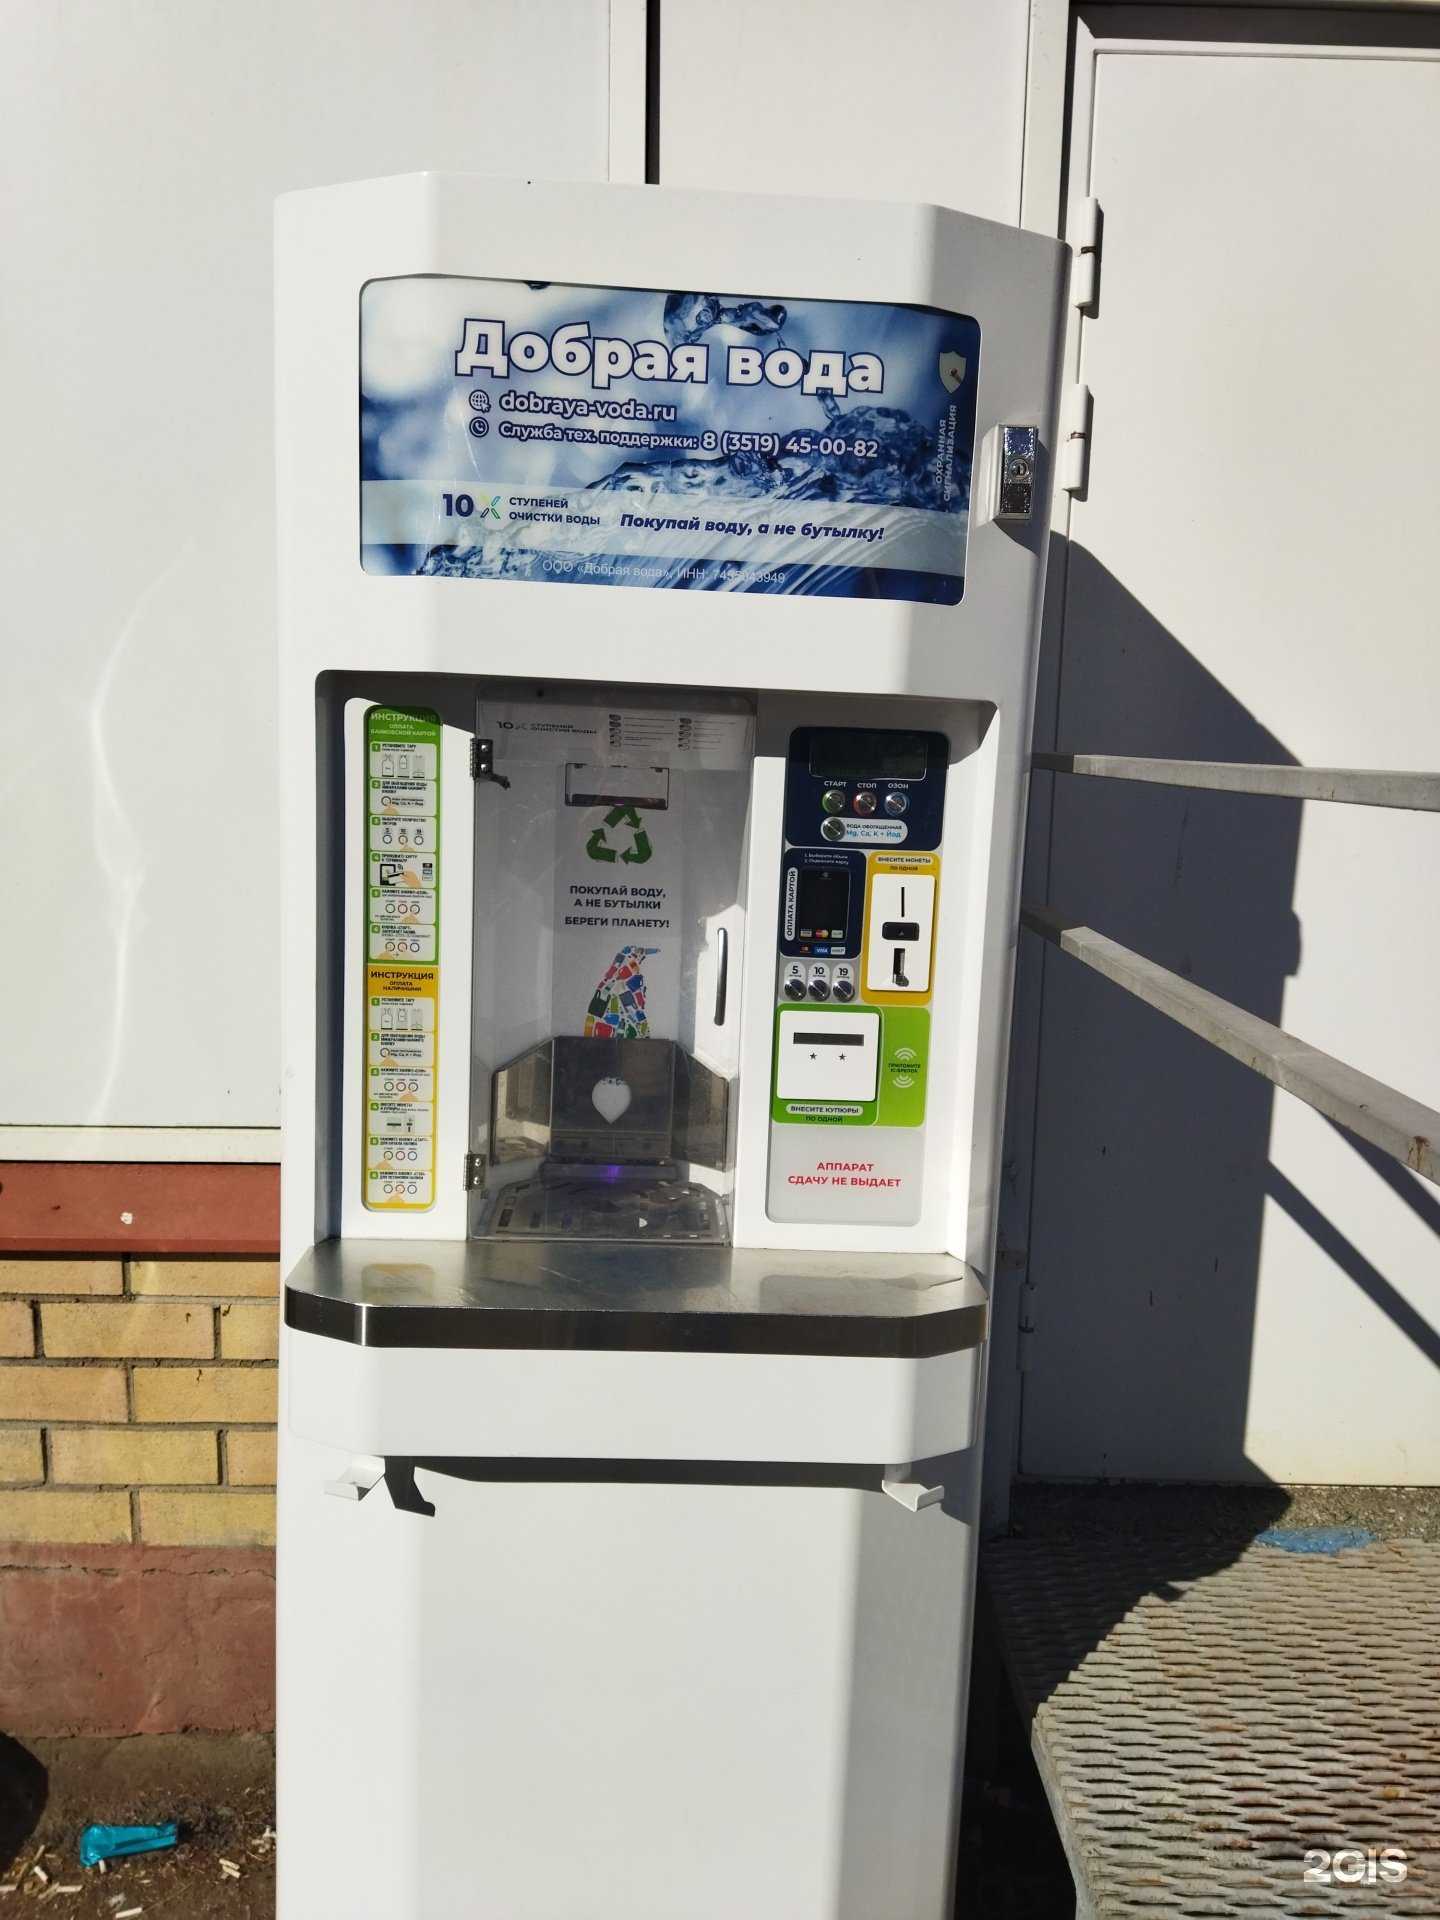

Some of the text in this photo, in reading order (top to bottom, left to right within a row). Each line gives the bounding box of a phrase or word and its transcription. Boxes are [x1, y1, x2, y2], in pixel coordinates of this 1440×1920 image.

[455, 317, 885, 398] Добрая вода
[500, 390, 677, 421] dobraya-voda.ru
[499, 422, 878, 458] Служба тех. поддержки: 8 (3519) 45-00-82
[936, 419, 946, 484] ОХРАННАЯ
[944, 404, 957, 501] СИГНАЛИЗАЦИЯ
[442, 493, 474, 517] 10
[509, 497, 569, 509] СТУПЕНЕЙ
[509, 511, 600, 526] ОЧИСТКИ ВОДЫ
[620, 513, 884, 542] Покупай воду, а не бутылку!
[542, 560, 574, 573] ООО
[577, 562, 630, 577] «Добрая
[570, 884, 666, 898] ПОКУПАЙ ВОДУ,
[788, 870, 796, 903] КАРТОЙ
[574, 899, 661, 910] А НЕ БУТЫЛКИ
[565, 916, 669, 929] БЕРЕГИ ПЛАНЕТУ!
[371, 971, 434, 980] ИНСТРУКЦИЯ
[792, 966, 848, 976] 5 10 19
[816, 1162, 874, 1172] АППАРАТ
[788, 1176, 901, 1188] СДАЧУ НЕ ВЫДАЕТ
